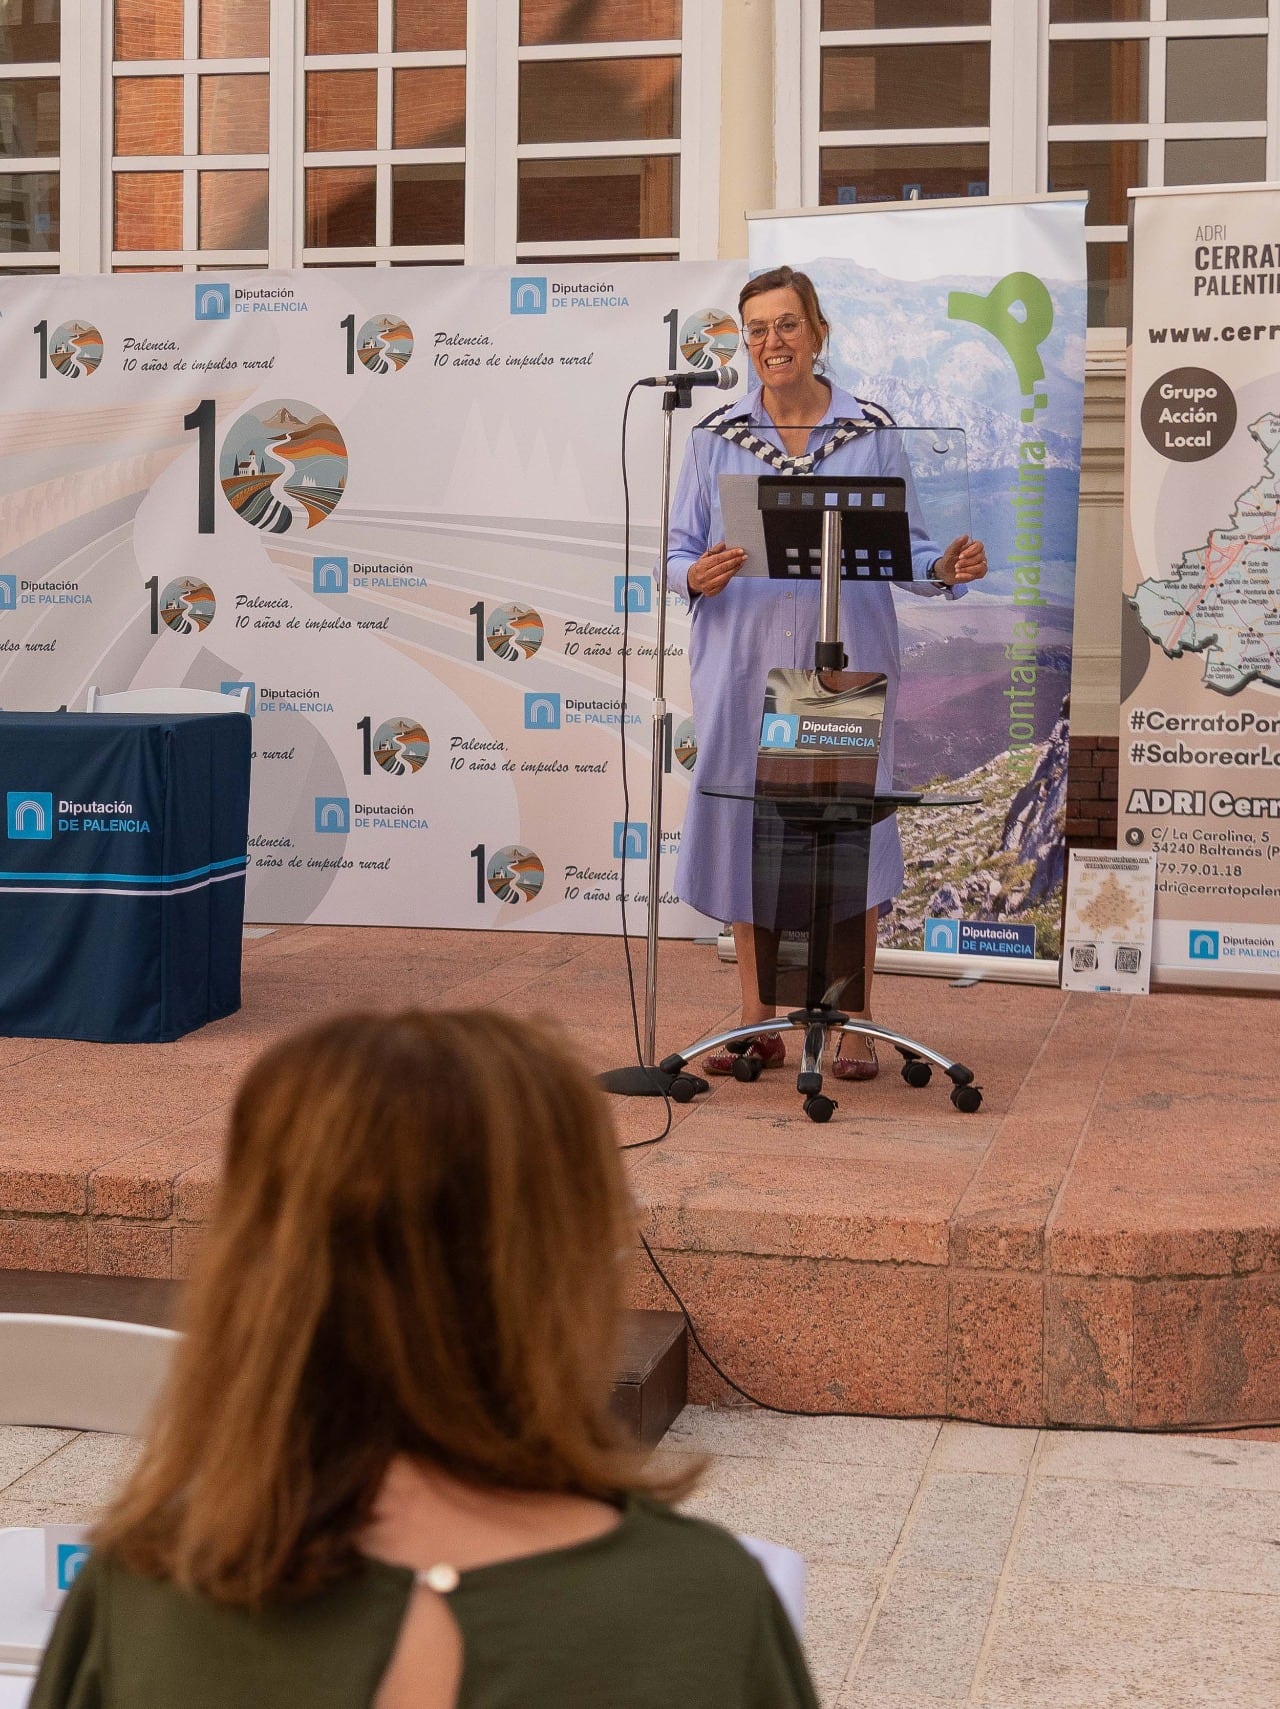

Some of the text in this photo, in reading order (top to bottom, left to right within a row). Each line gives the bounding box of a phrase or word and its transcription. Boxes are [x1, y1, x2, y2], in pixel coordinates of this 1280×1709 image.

[1195, 225, 1227, 241] ADRI
[235, 289, 294, 301] Diputación
[553, 283, 613, 295] Diputación
[235, 302, 308, 313] DE PALENCIA
[552, 296, 629, 308] DE PALENCIA
[122, 356, 275, 373] 10 años de impulso rural
[434, 351, 594, 370] 10 años de impulso rural
[1160, 384, 1217, 403] Grupo
[1159, 407, 1217, 423] Acción
[1165, 431, 1211, 447] Local
[354, 563, 413, 575] Diputación
[21, 580, 79, 593] Diputación
[353, 577, 429, 588] DE PALENCIA
[21, 594, 93, 605] DE PALENCIA
[1004, 441, 1048, 772] montaña palentina
[235, 615, 390, 633] 10 años de impulso rural
[25, 639, 56, 652] rural
[564, 643, 580, 656] 10
[584, 644, 612, 656] años
[261, 688, 320, 701] Diputación
[261, 703, 334, 713] DE PALENCIA
[566, 699, 627, 712] Diputación
[566, 714, 642, 725] DE PALENCIA
[803, 720, 863, 735] Diputación
[801, 734, 875, 748] DE PALENCIA
[262, 747, 296, 760] rural
[450, 757, 608, 776] 10 años de impulso rural
[59, 800, 133, 815] Diputación
[1126, 788, 1206, 816] ADRI
[355, 804, 414, 817] Diputación
[59, 819, 151, 833] DE PALENCIA
[354, 818, 429, 830] DE PALENCIA
[1151, 827, 1270, 844] C/ La Carolina, 5
[1151, 841, 1280, 861] 34240 Baltanás (P
[255, 855, 392, 872] años de impulso rural
[1156, 863, 1242, 877] 79.79.01.18
[564, 886, 580, 900] 10
[583, 888, 611, 902] años
[962, 926, 1020, 942] Diputación
[1223, 935, 1275, 947] Diputación
[962, 940, 1033, 956] DE PALENCIA
[1223, 947, 1280, 958] DE PALENCI
